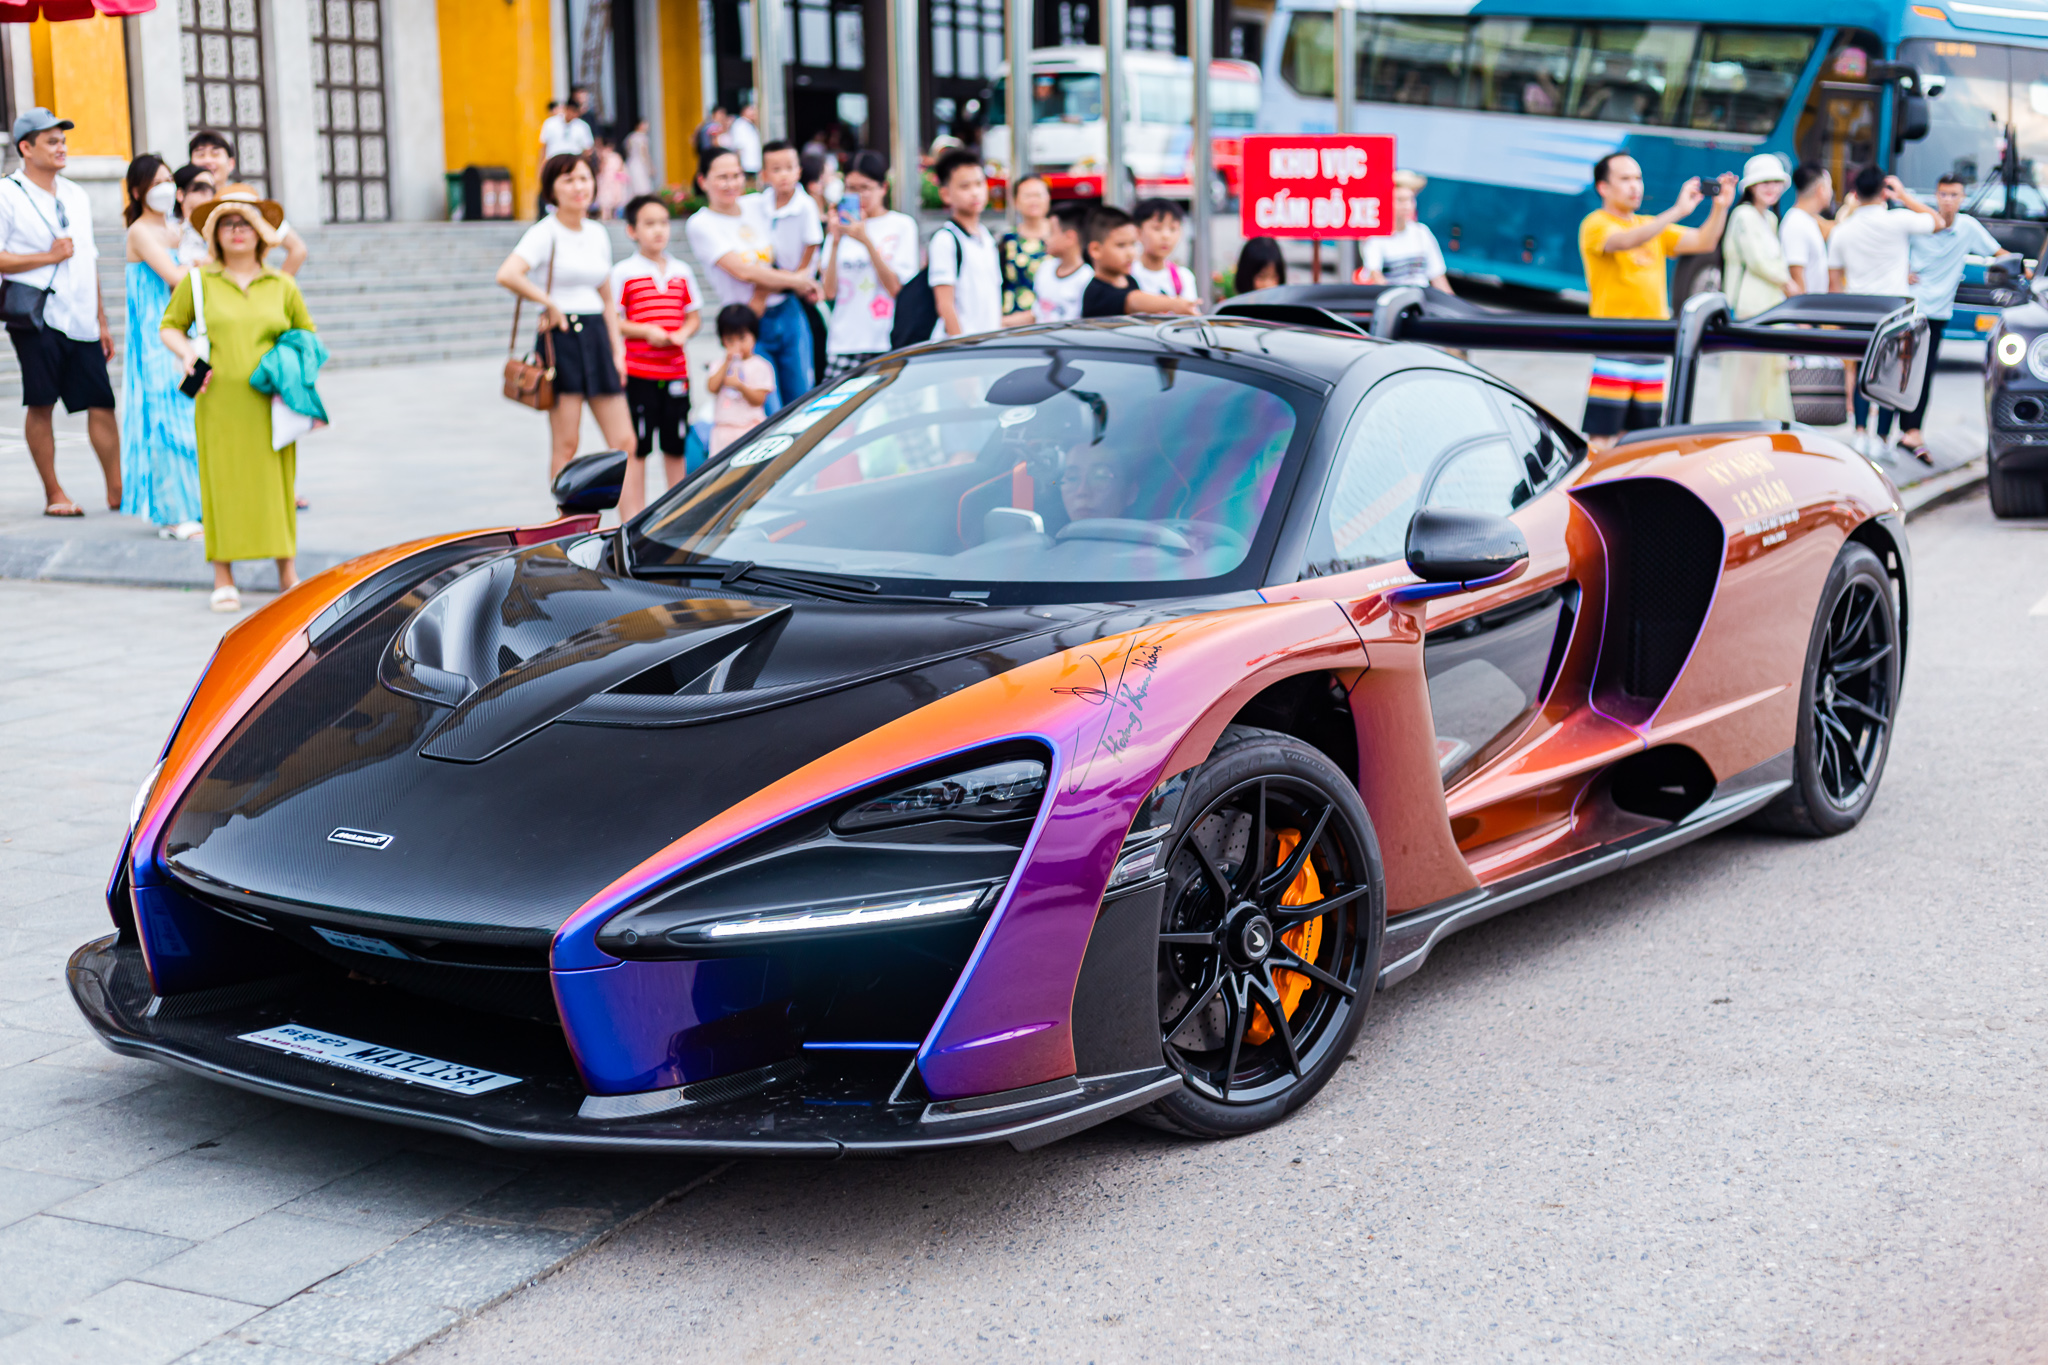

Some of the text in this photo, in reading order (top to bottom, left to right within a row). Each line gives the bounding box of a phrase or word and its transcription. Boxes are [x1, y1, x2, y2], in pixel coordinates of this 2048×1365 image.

[1269, 145, 1367, 185] KHU VỰC
[1255, 188, 1310, 228] CẤM
[1348, 197, 1380, 228] XE
[1731, 490, 1758, 519] 13
[1286, 752, 1326, 772] TROFEO
[334, 832, 380, 844] McLaren
[250, 1034, 324, 1054] CAMBODIA
